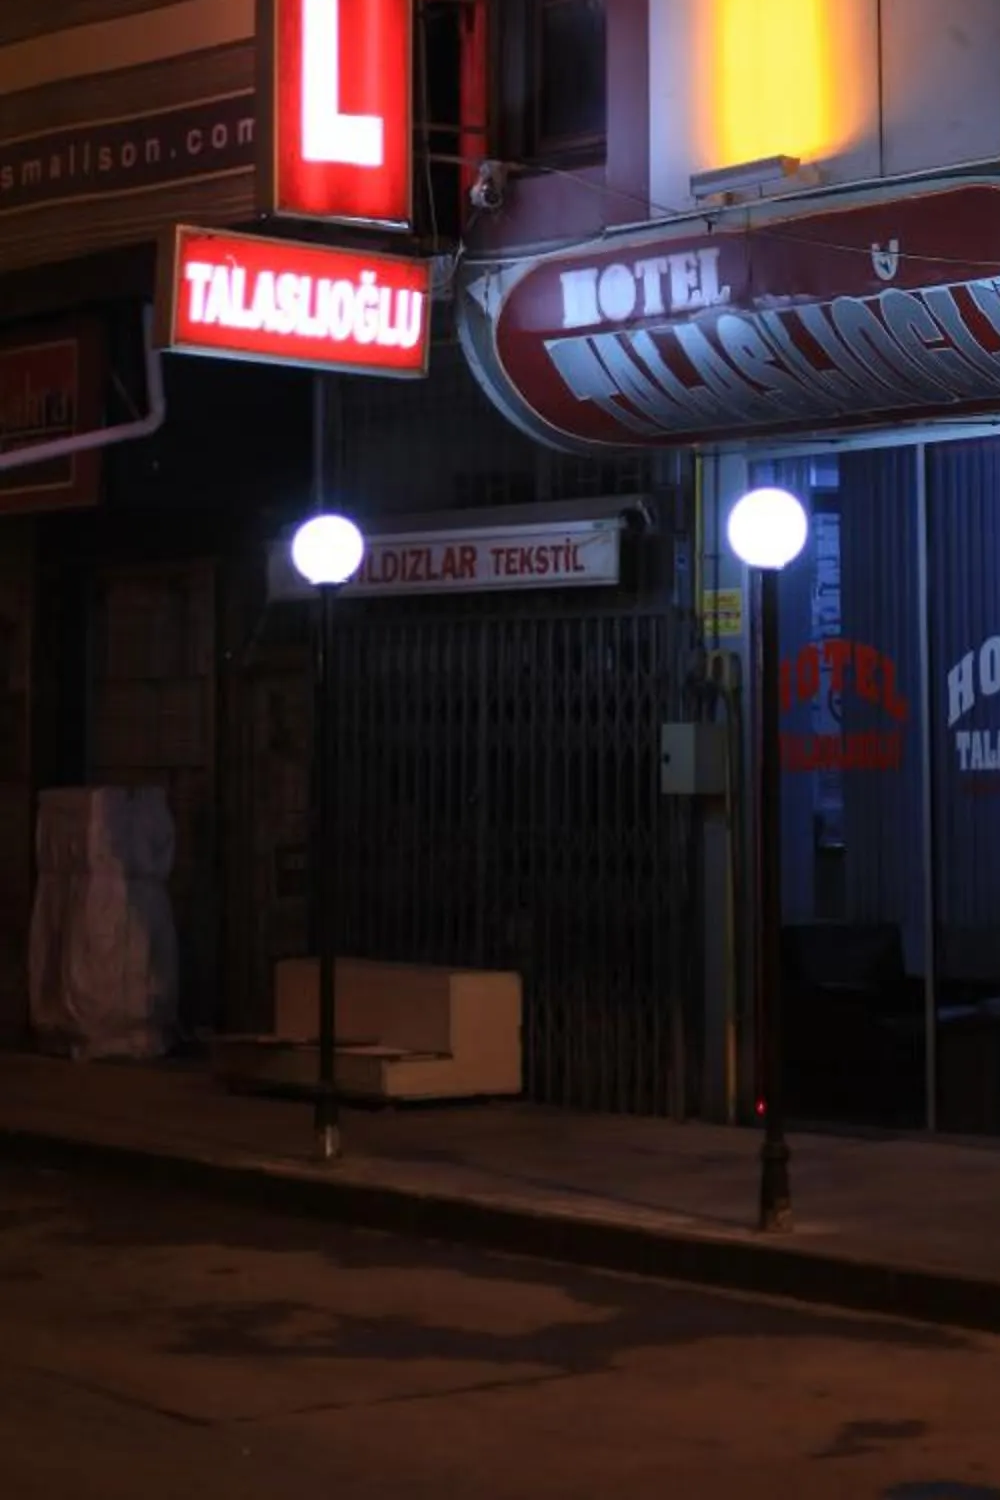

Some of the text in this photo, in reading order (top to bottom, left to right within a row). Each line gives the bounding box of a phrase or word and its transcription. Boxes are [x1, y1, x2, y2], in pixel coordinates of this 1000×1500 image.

[185, 262, 423, 348] TALASLIOĞLU
[559, 246, 732, 329] HOTEL
[356, 538, 585, 584] ILDIZLAR TEKSTİL
